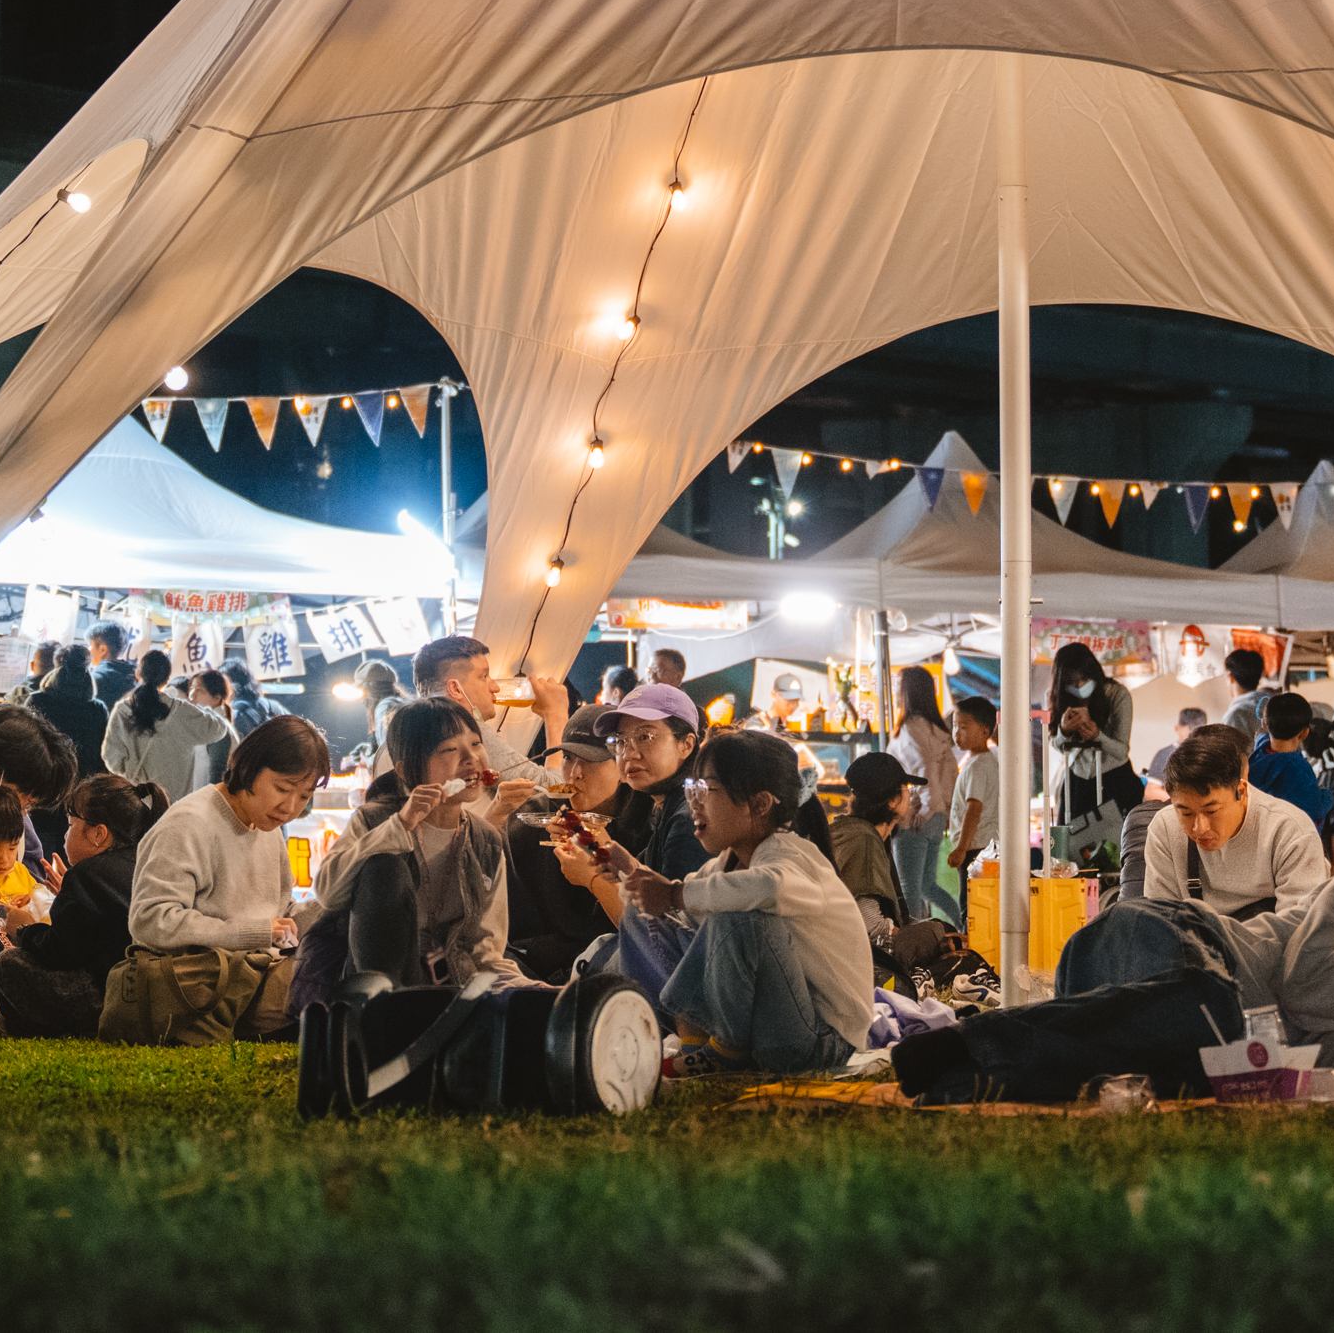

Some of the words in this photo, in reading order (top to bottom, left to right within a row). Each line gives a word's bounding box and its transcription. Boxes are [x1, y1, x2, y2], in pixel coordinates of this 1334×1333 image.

[164, 591, 248, 613] 魷魚雞排
[182, 631, 212, 674] 魚
[258, 630, 293, 673] 雞
[328, 618, 364, 653] 排
